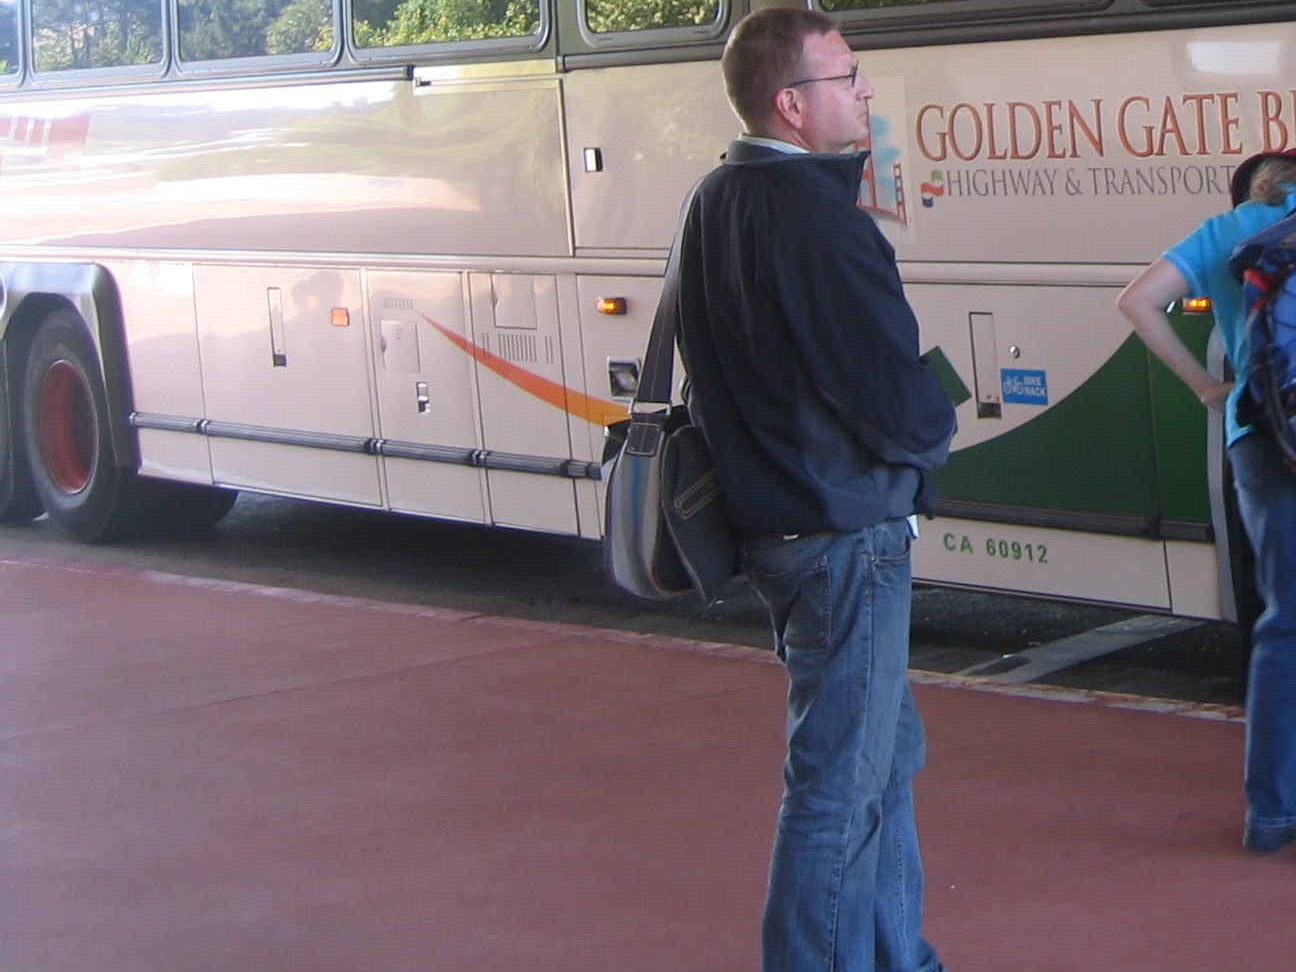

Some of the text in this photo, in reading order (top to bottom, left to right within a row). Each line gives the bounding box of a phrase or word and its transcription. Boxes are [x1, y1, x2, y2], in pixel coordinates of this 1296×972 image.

[915, 99, 1104, 162] GOLDEN
[1117, 92, 1243, 158] GATE
[946, 165, 1236, 197] HIGHWAY & TRANSPORT
[1023, 375, 1042, 386] BIKE
[1024, 386, 1047, 397] RACK
[943, 533, 1048, 564] CA 60912
